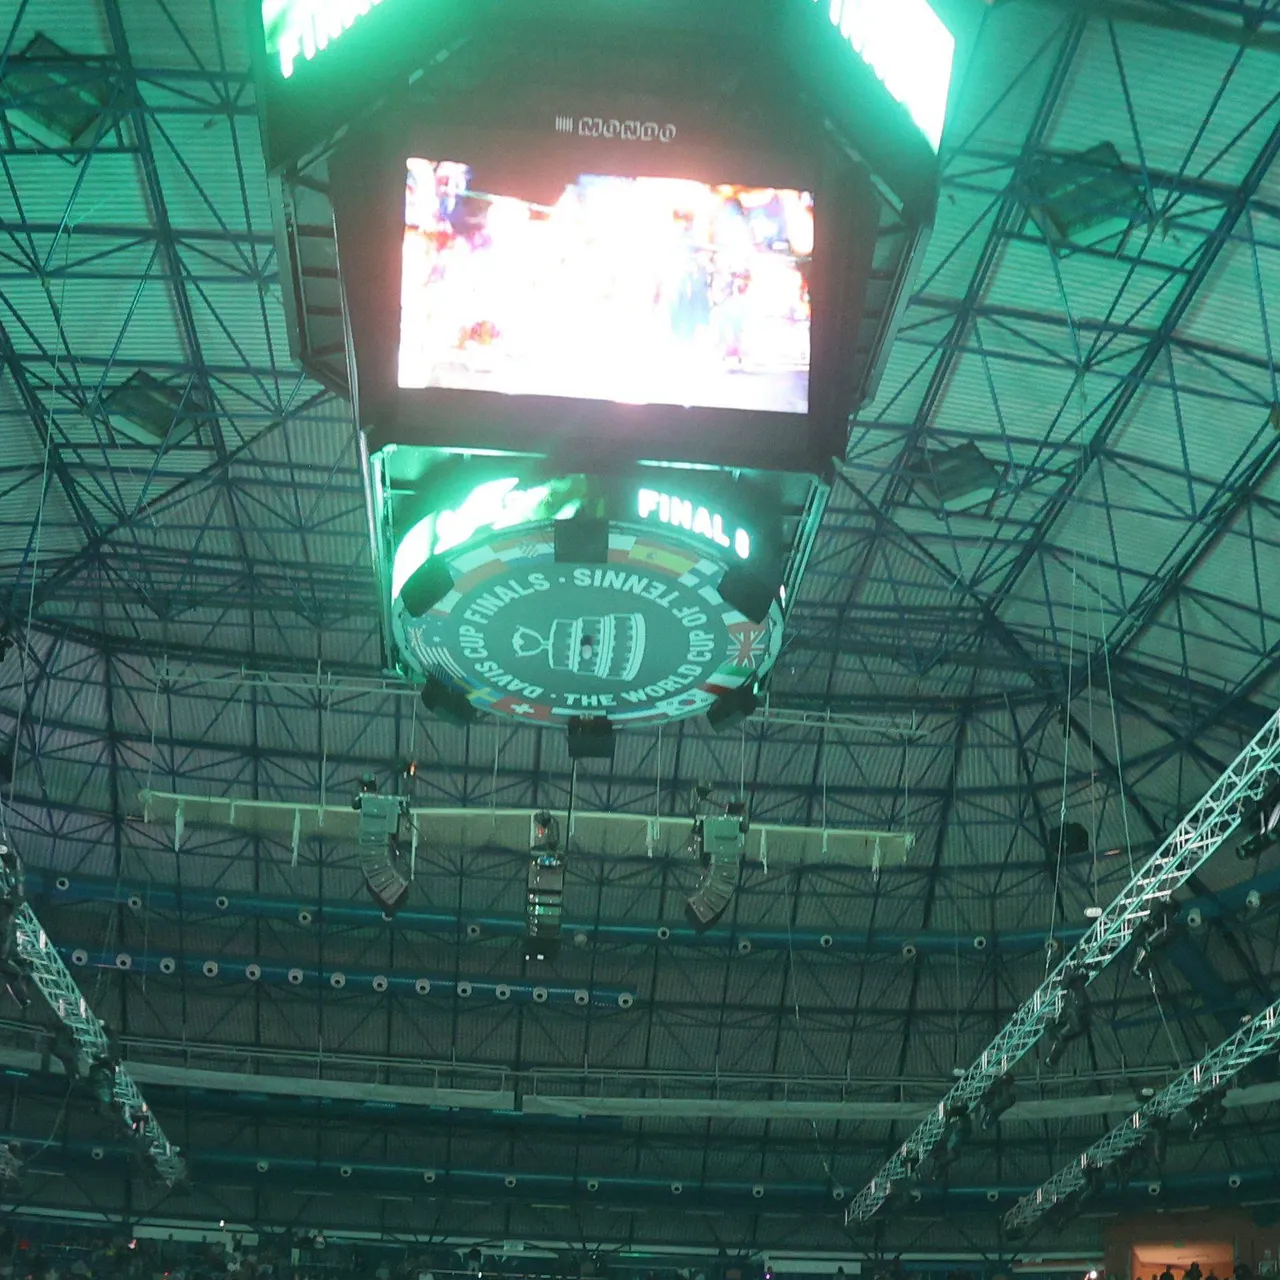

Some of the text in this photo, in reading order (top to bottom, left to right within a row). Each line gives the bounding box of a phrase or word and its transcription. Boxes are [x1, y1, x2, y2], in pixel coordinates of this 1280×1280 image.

[578, 116, 677, 142] MONDO
[458, 572, 551, 699] DAVIS CUP FINALS
[563, 568, 715, 707] THE WORLD CUP OF TENNIS
